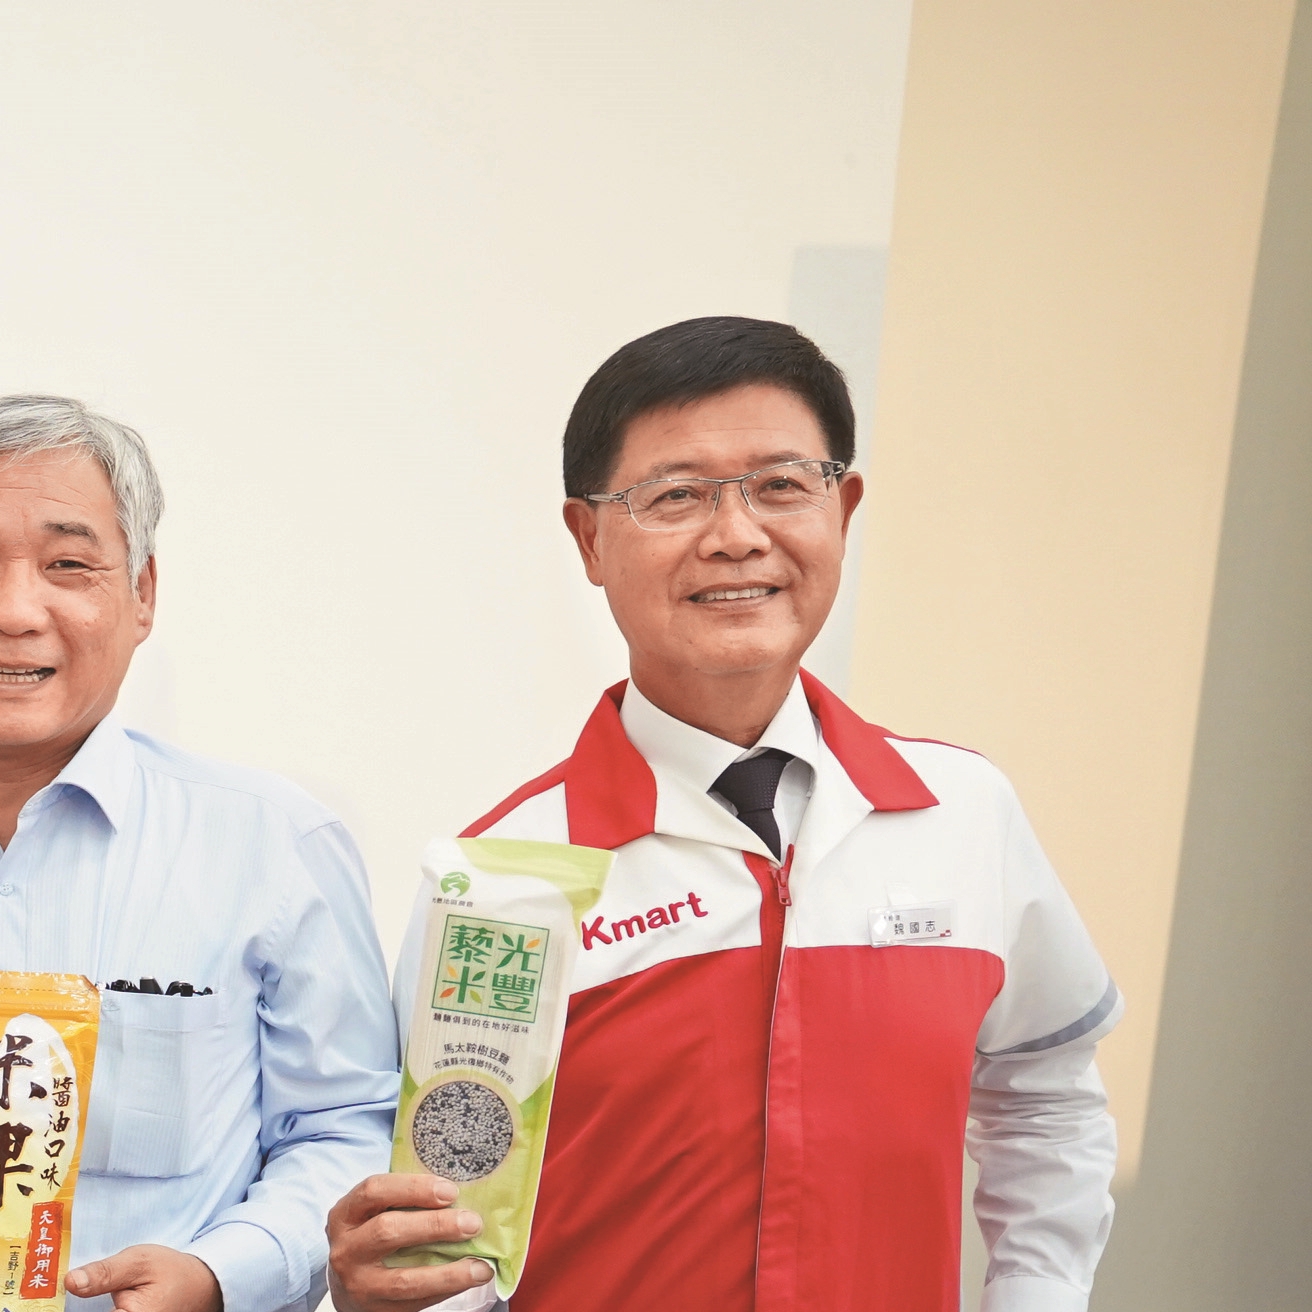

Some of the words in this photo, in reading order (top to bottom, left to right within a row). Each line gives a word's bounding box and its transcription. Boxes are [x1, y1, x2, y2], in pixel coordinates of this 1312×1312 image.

[581, 892, 708, 950] Kmart
[433, 1056, 516, 1085] 花蓮縣光復鄉特有作物
[443, 1041, 510, 1066] 馬太鞍樹豆麵
[40, 1076, 74, 1191] 醬油口味
[27, 1209, 54, 1289] 天皇御用米
